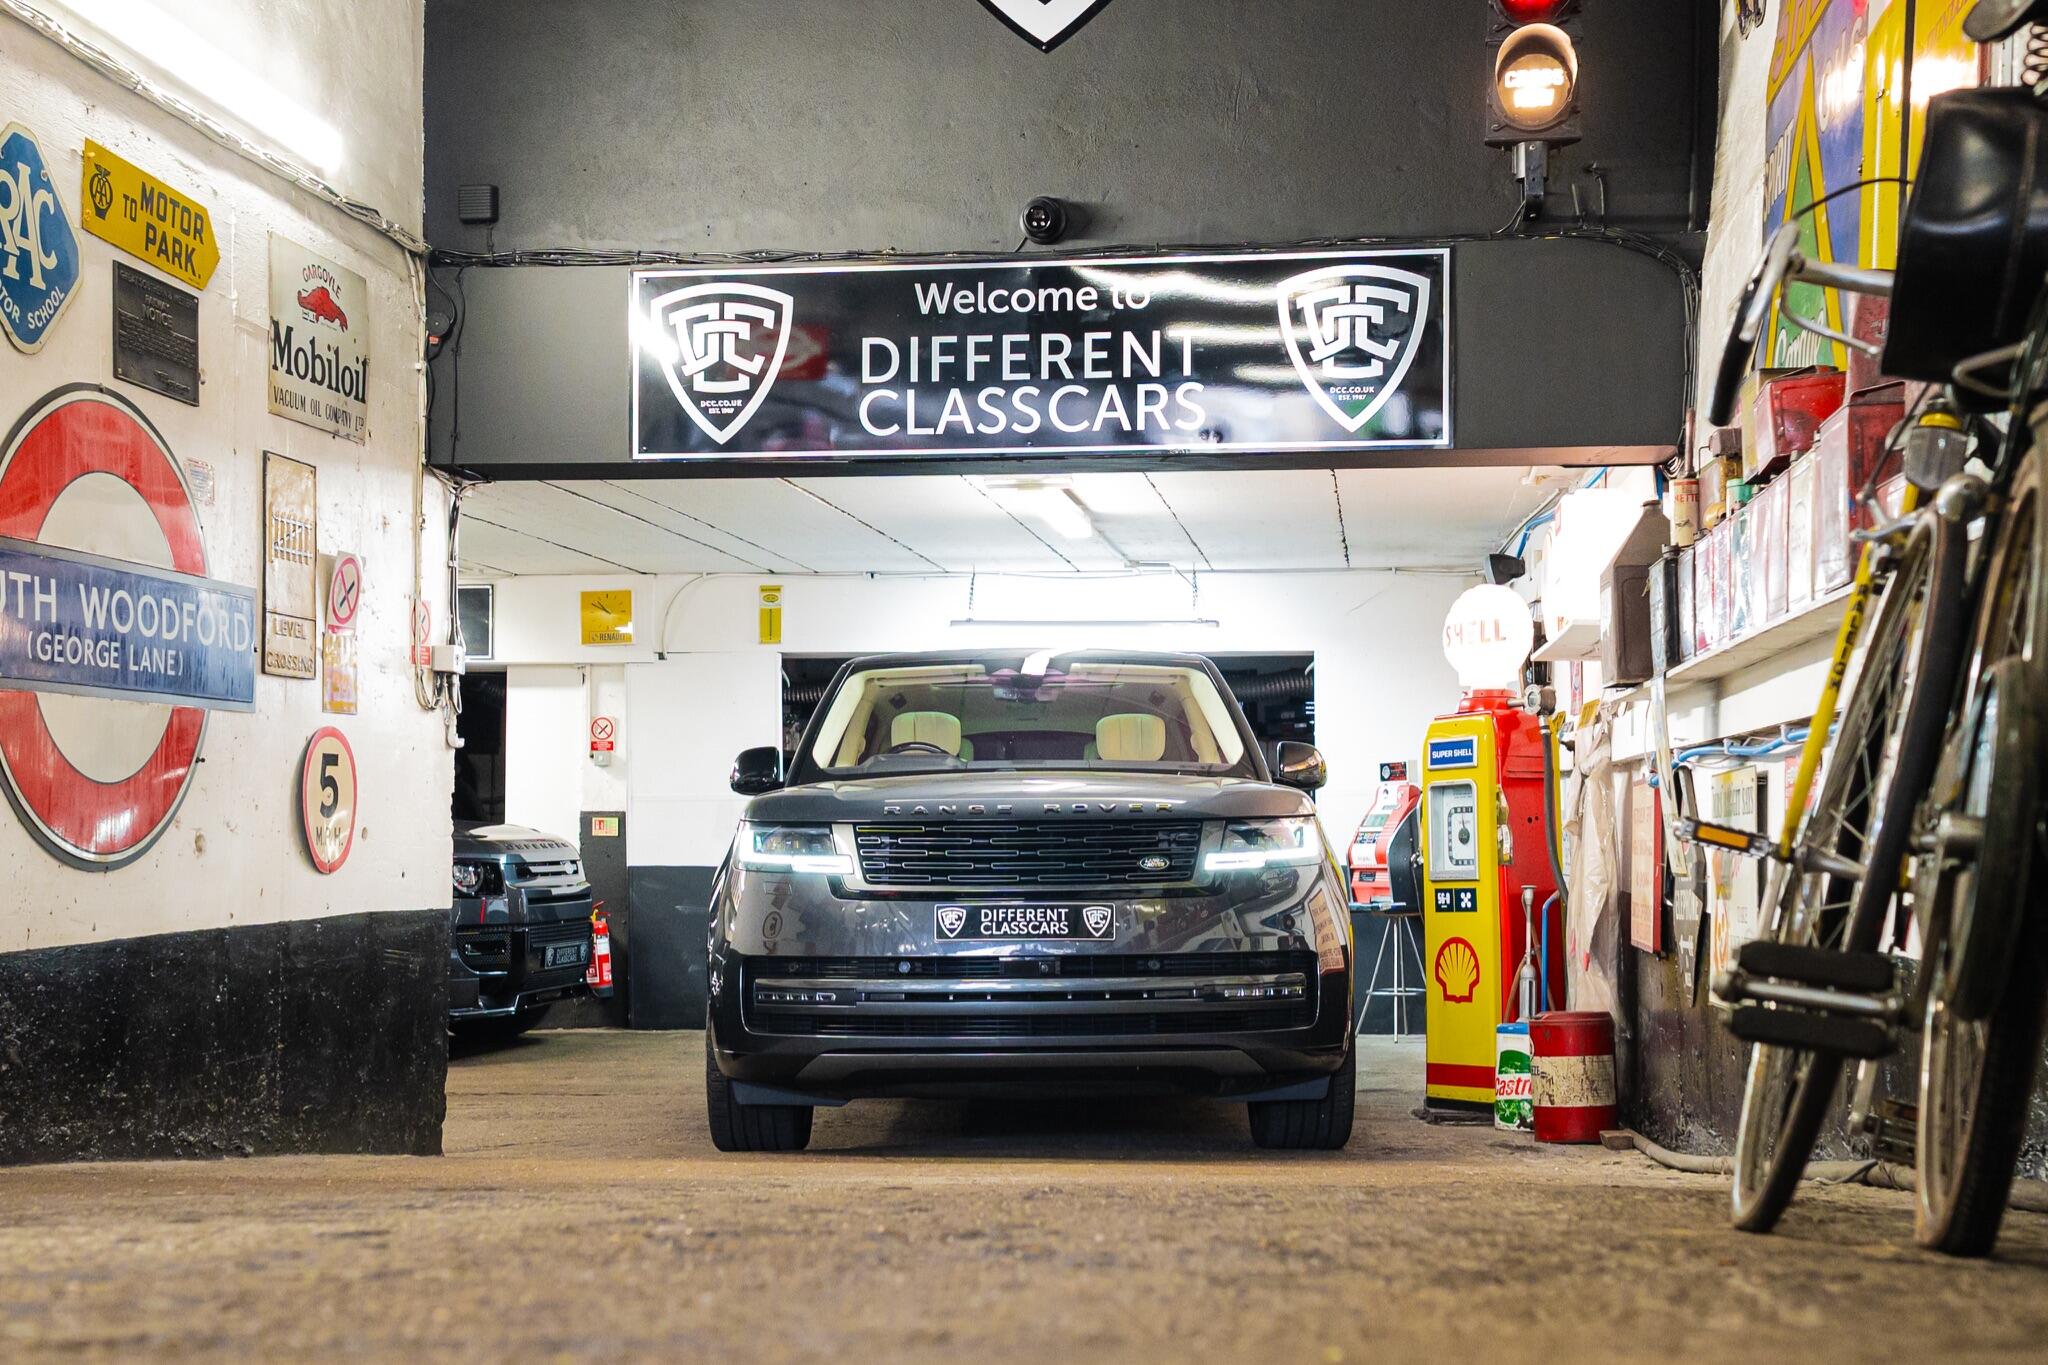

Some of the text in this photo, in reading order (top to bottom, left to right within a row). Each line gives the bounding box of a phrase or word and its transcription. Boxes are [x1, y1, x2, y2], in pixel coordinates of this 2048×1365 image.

[123, 181, 204, 245] TO MOTOR
[302, 263, 342, 299] GARGOYLE
[914, 281, 1151, 314] Welcome to
[0, 279, 66, 329] TOR SCHOOL
[271, 318, 369, 404] Mobiloil
[861, 329, 1204, 384] DIFFERENT
[700, 399, 743, 408] DCC.CO.UK
[1329, 386, 1375, 394] DCC.CO.UK
[273, 385, 365, 432] VACUUM OIL COMPANY LTD
[858, 381, 1206, 437] CLASSCARS
[78, 583, 250, 651] WOODFORD
[272, 616, 308, 640] LEVEL
[27, 630, 184, 677] (GEORGE LANE)
[266, 650, 314, 674] CROSSING
[1432, 748, 1473, 759] SUPER SHELL
[319, 752, 339, 819] 5
[883, 802, 1173, 815] RANGE ROVER
[980, 908, 1069, 922] DIFFERENT
[980, 921, 1069, 935] CLASSCARS
